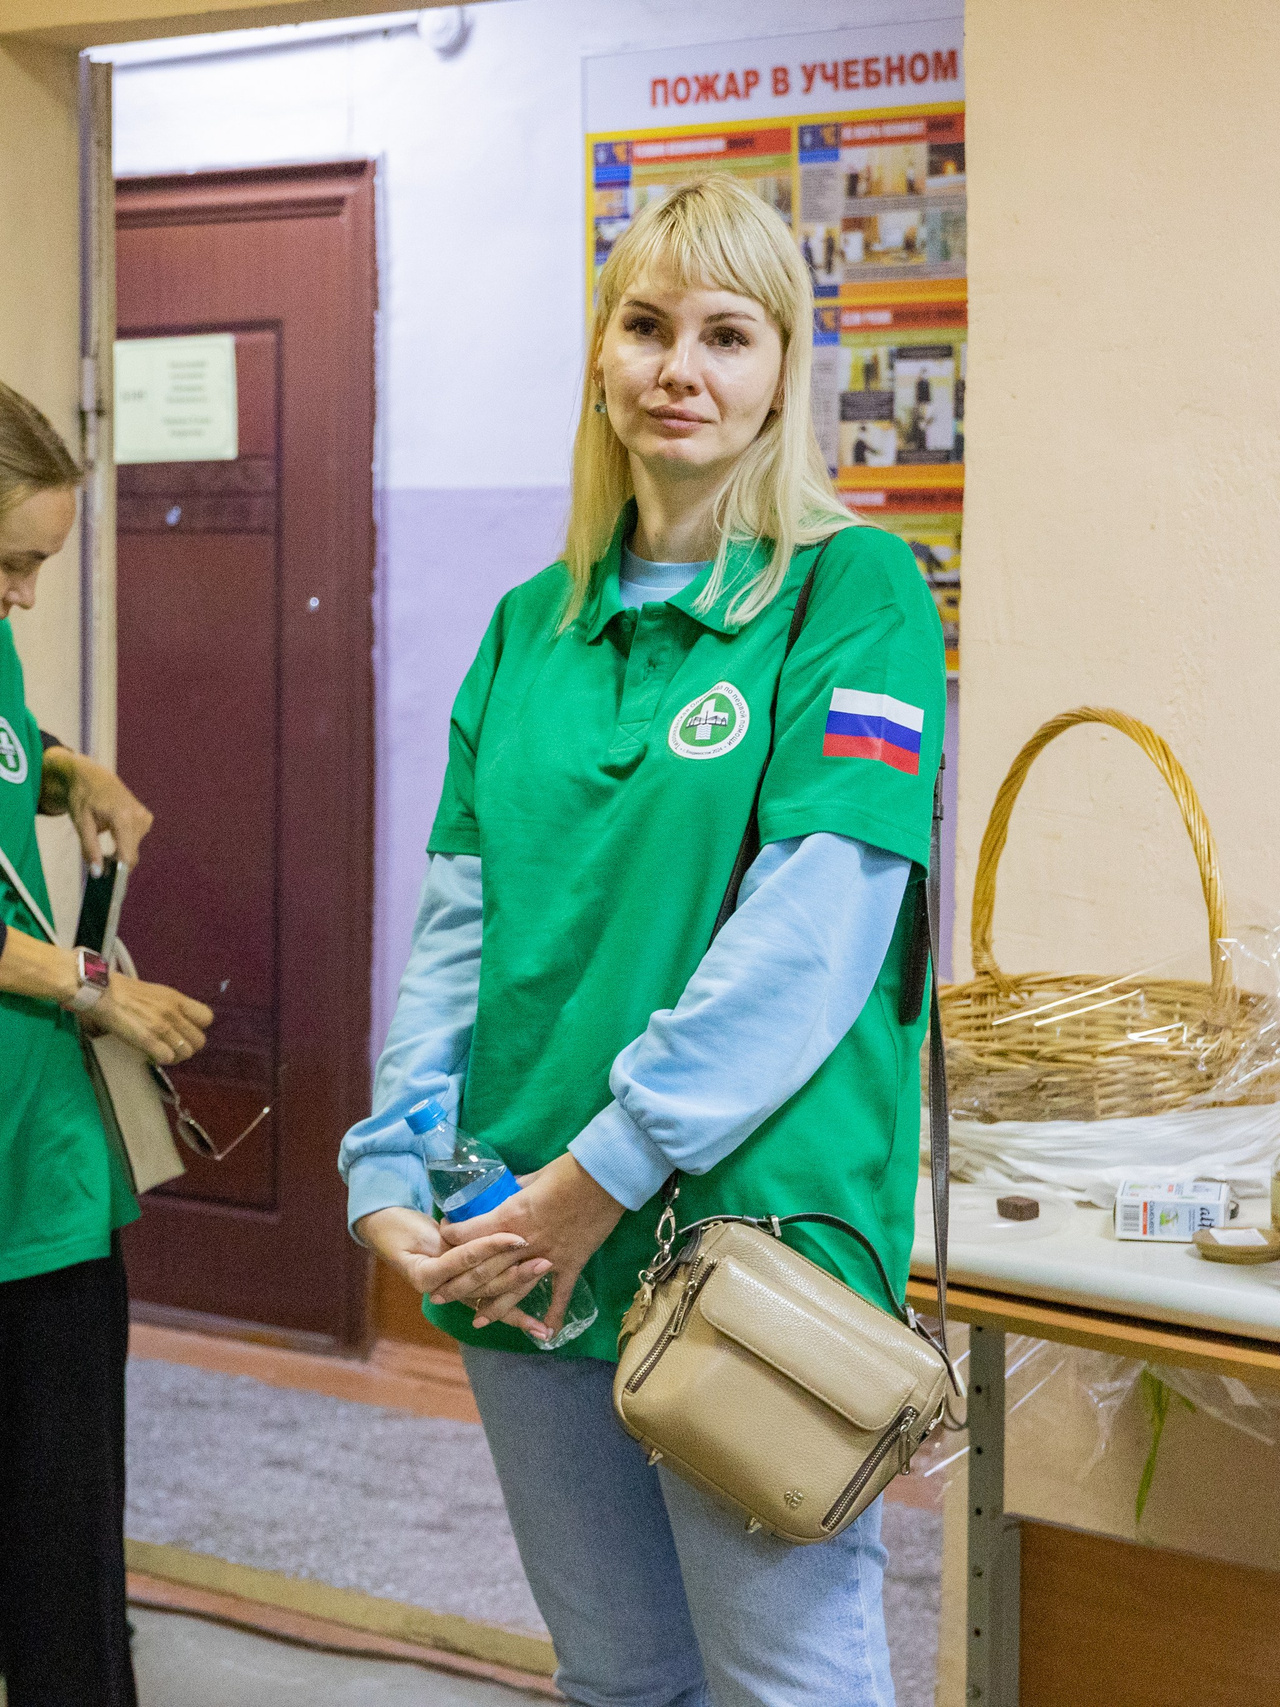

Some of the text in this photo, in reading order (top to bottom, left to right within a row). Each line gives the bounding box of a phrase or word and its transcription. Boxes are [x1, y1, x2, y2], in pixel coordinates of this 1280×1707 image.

[650, 49, 958, 107] ПОЖАР В УЧЕБНОМ
[732, 694, 746, 718] первой
